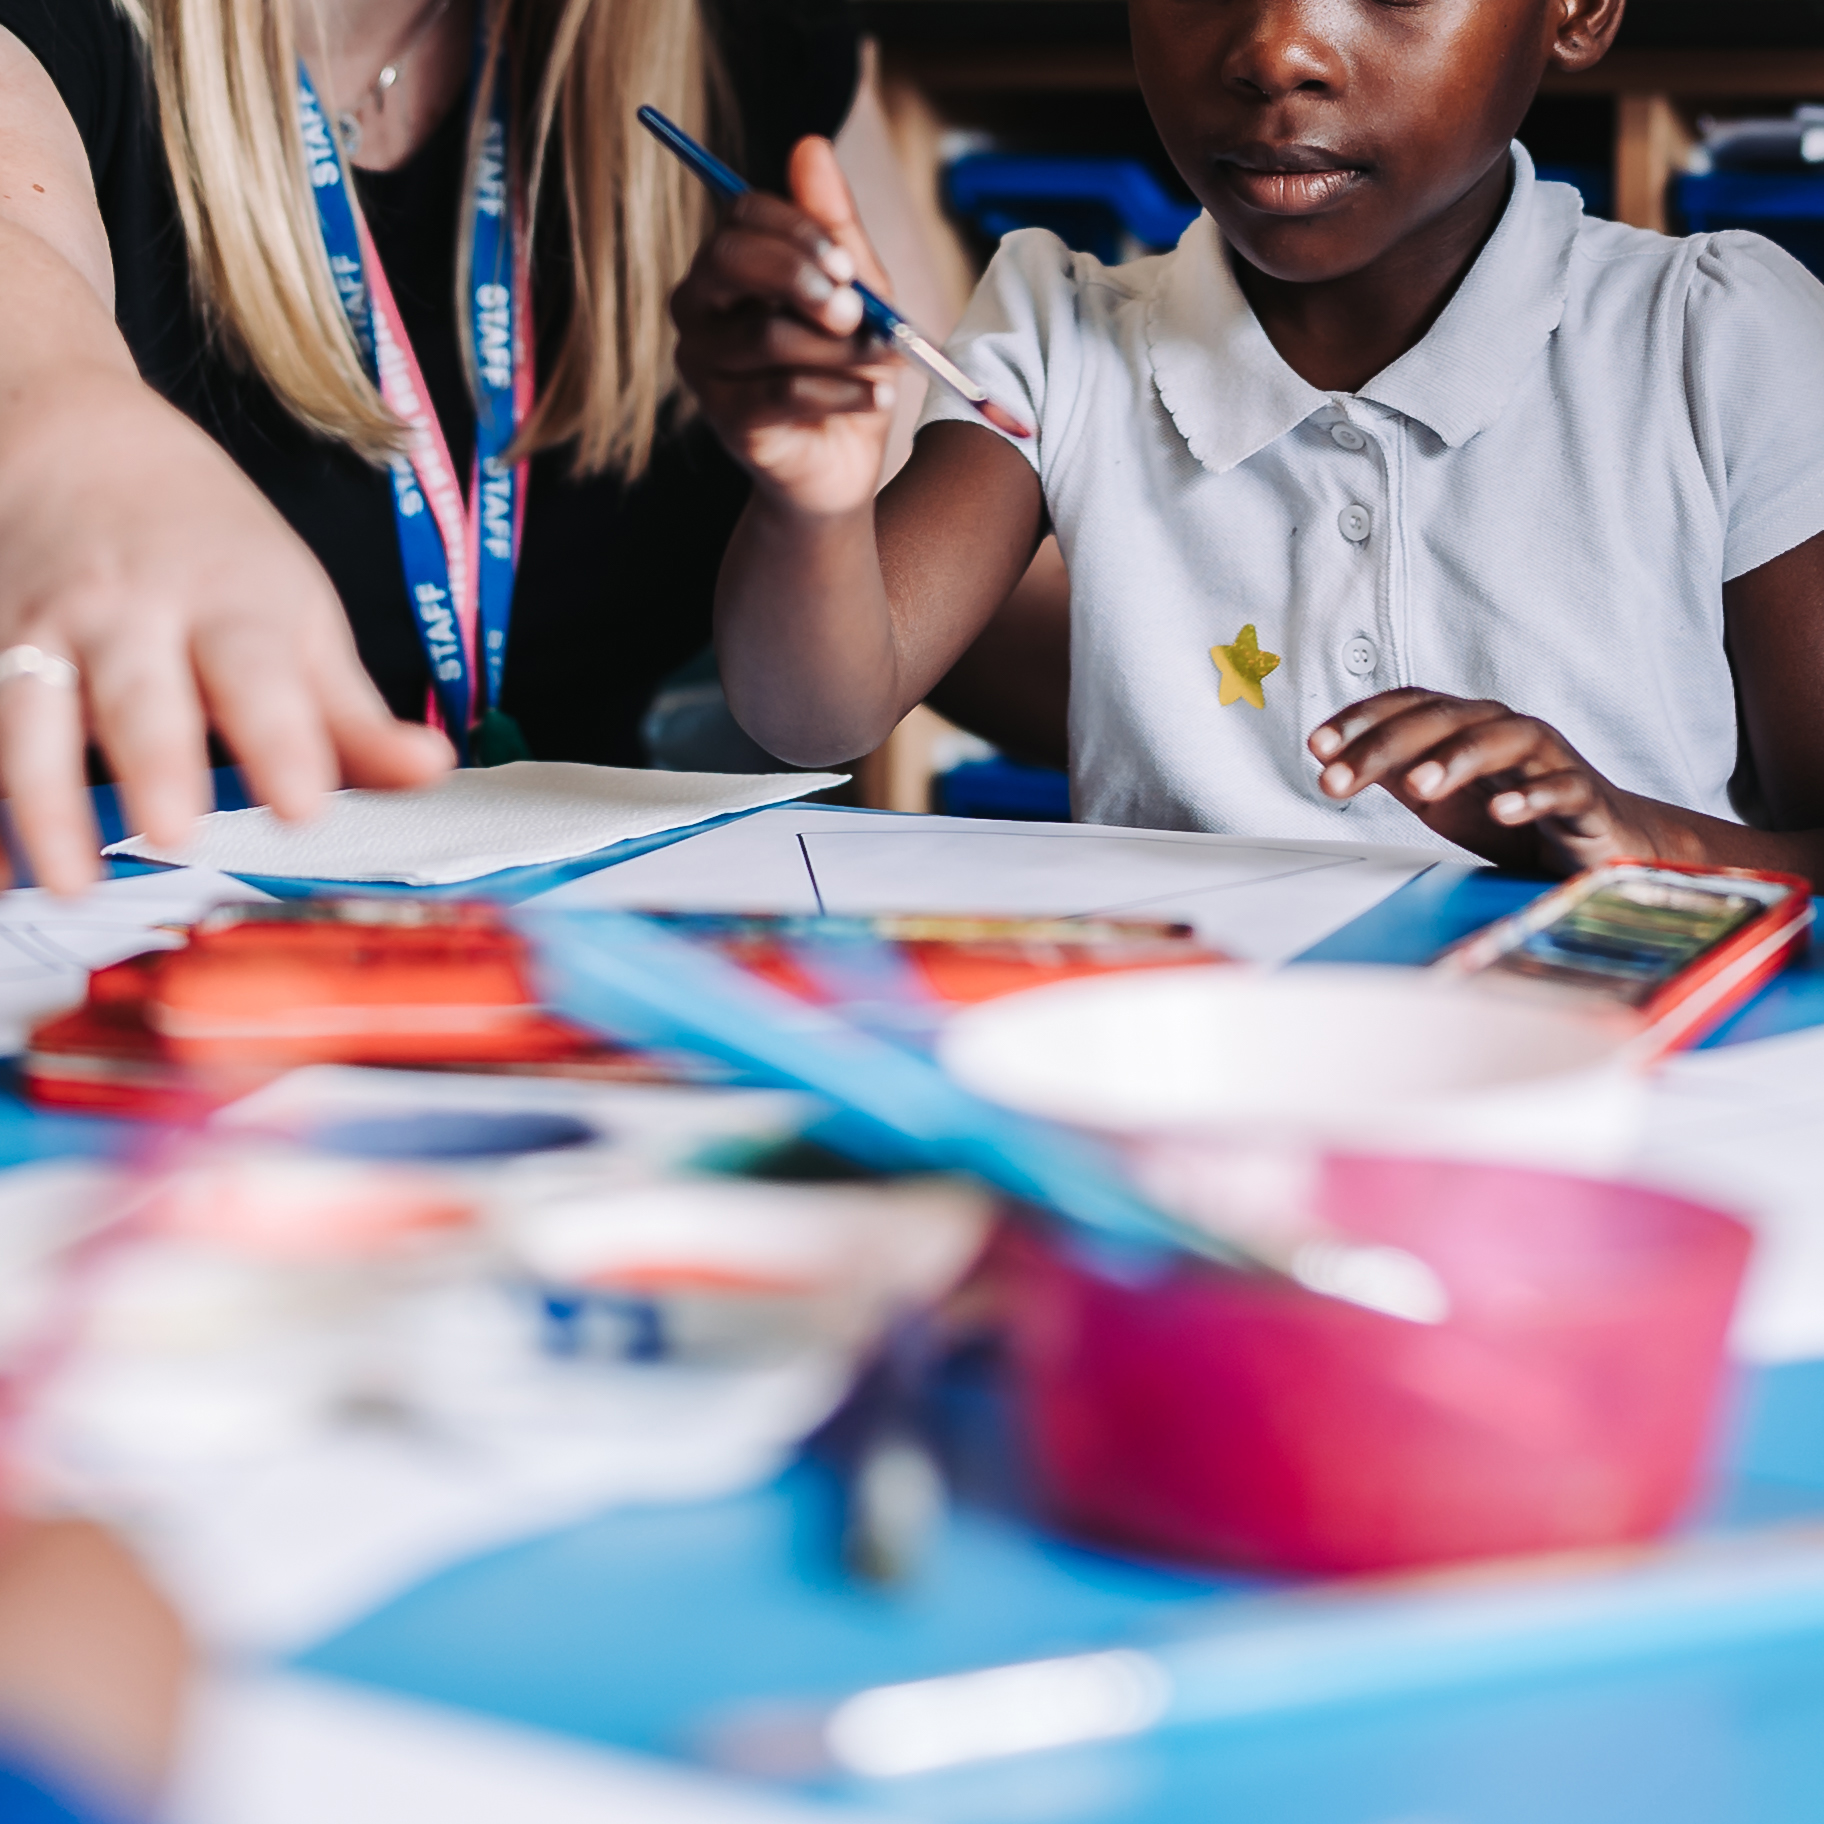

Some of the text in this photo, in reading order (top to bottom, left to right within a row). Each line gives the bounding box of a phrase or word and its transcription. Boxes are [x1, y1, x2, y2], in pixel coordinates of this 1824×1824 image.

[475, 282, 511, 390] STAFF
[482, 455, 512, 560] STAFF
[414, 581, 462, 682] STAFF
